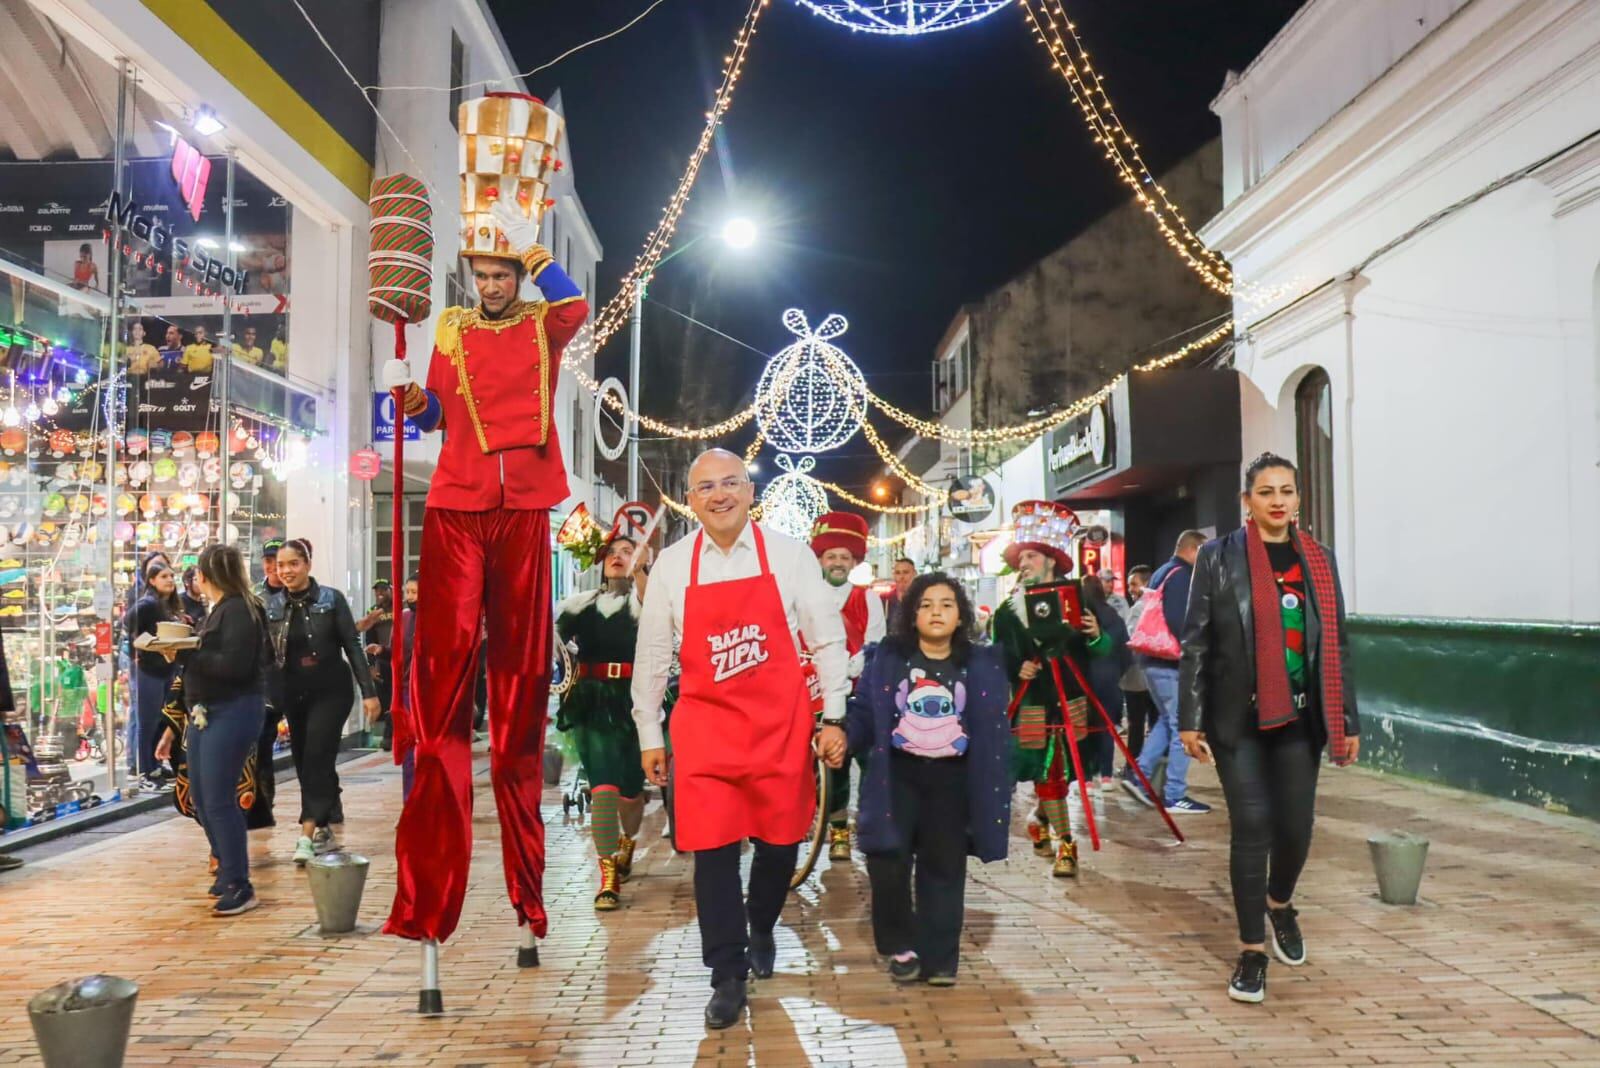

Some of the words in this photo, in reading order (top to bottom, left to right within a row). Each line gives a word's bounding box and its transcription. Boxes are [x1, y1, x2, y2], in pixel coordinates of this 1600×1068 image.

[173, 404, 196, 412] GOLTY
[376, 425, 416, 434] PARNG
[707, 624, 767, 652] BAZAR
[710, 641, 769, 683] ZIPA
